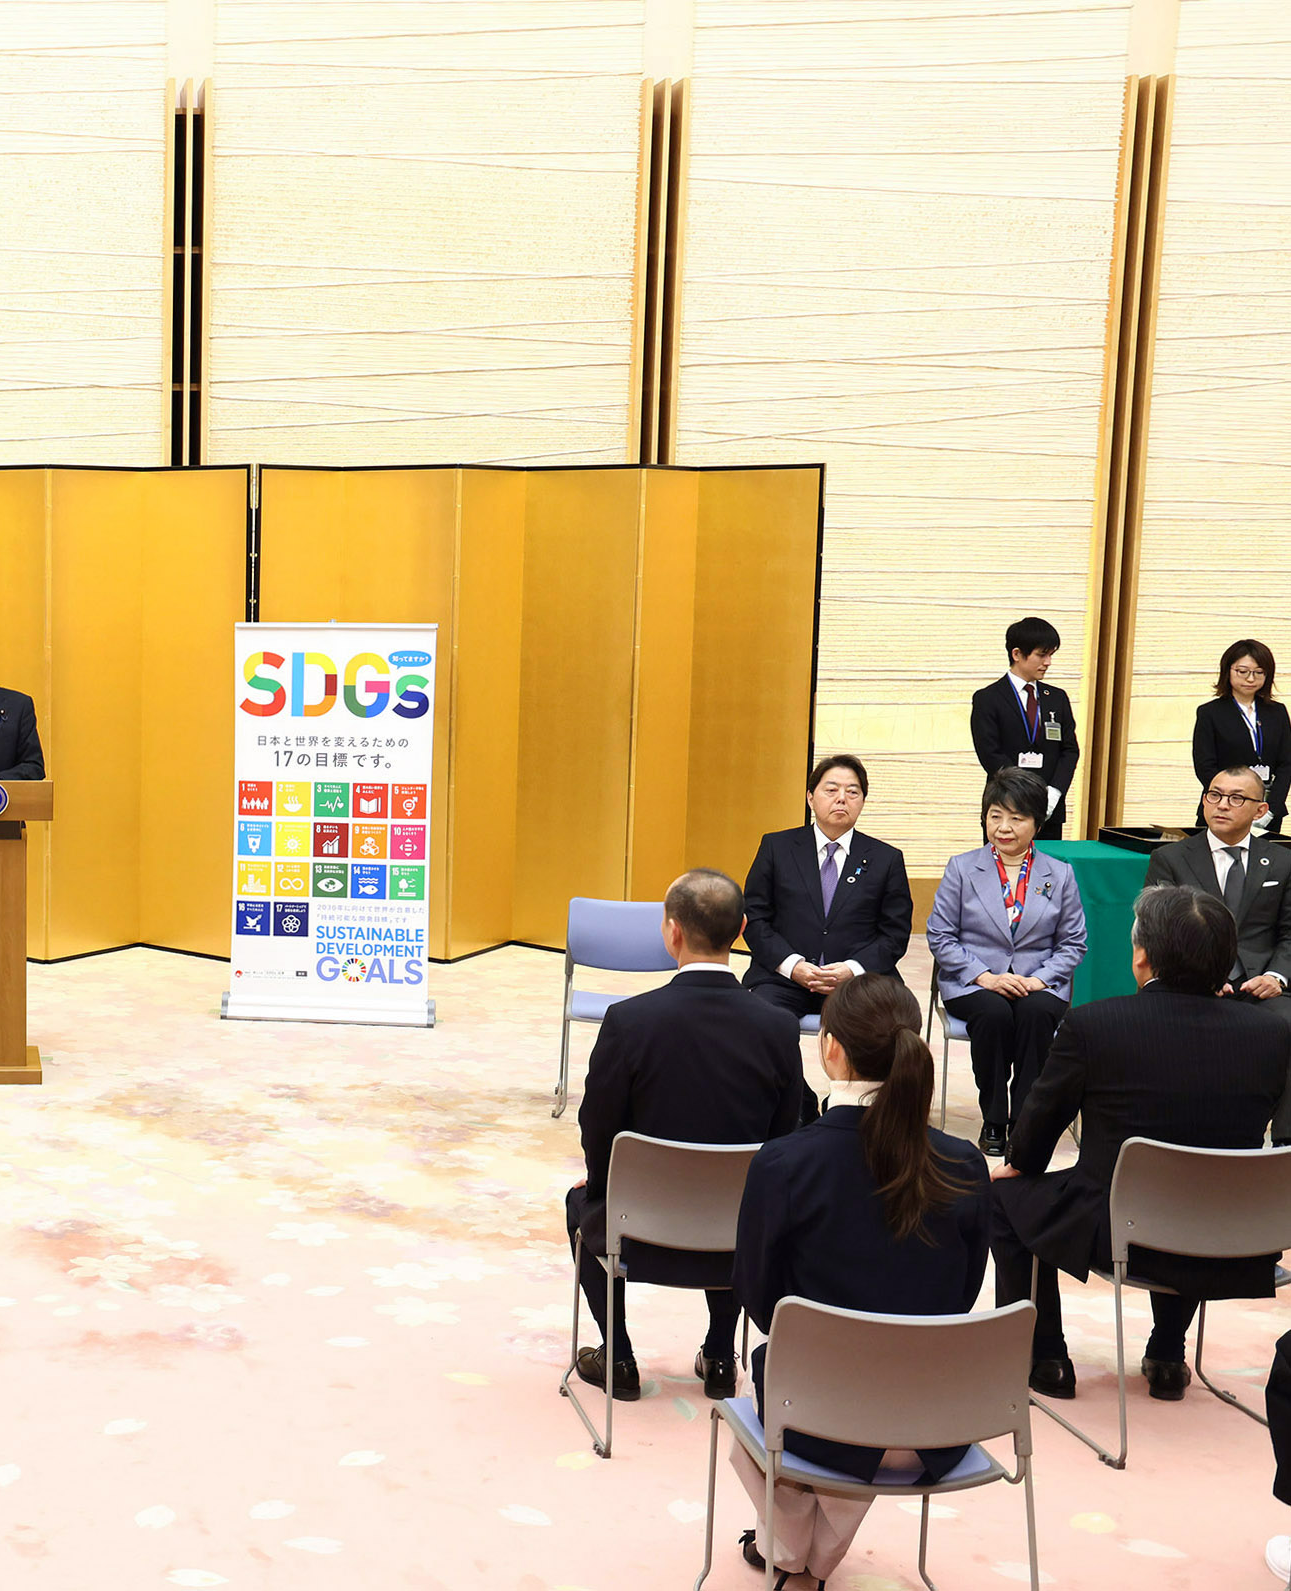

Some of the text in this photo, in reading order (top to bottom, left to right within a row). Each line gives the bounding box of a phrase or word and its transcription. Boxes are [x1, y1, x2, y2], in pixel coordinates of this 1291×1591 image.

[239, 651, 430, 719] SDGs
[257, 735, 409, 749] 日本と世界を変えるための
[274, 750, 392, 769] 17の目標です。
[242, 784, 246, 792] 1
[278, 784, 284, 793] 2
[316, 784, 322, 793] 3
[355, 785, 361, 794] 4
[394, 786, 400, 794] 5
[240, 822, 245, 832] 6
[316, 824, 322, 834] 8
[354, 826, 360, 834] 9
[394, 826, 402, 836] 10
[240, 863, 246, 872] 11
[276, 864, 284, 873] 12
[314, 864, 323, 874] 13
[353, 866, 361, 875] 14
[392, 867, 400, 876] 15
[238, 902, 246, 912] 16
[276, 904, 283, 912] 17
[316, 925, 424, 943] SUSTAINABLE
[316, 942, 424, 958] DEVELOPMENT
[316, 956, 424, 985] GOALS
